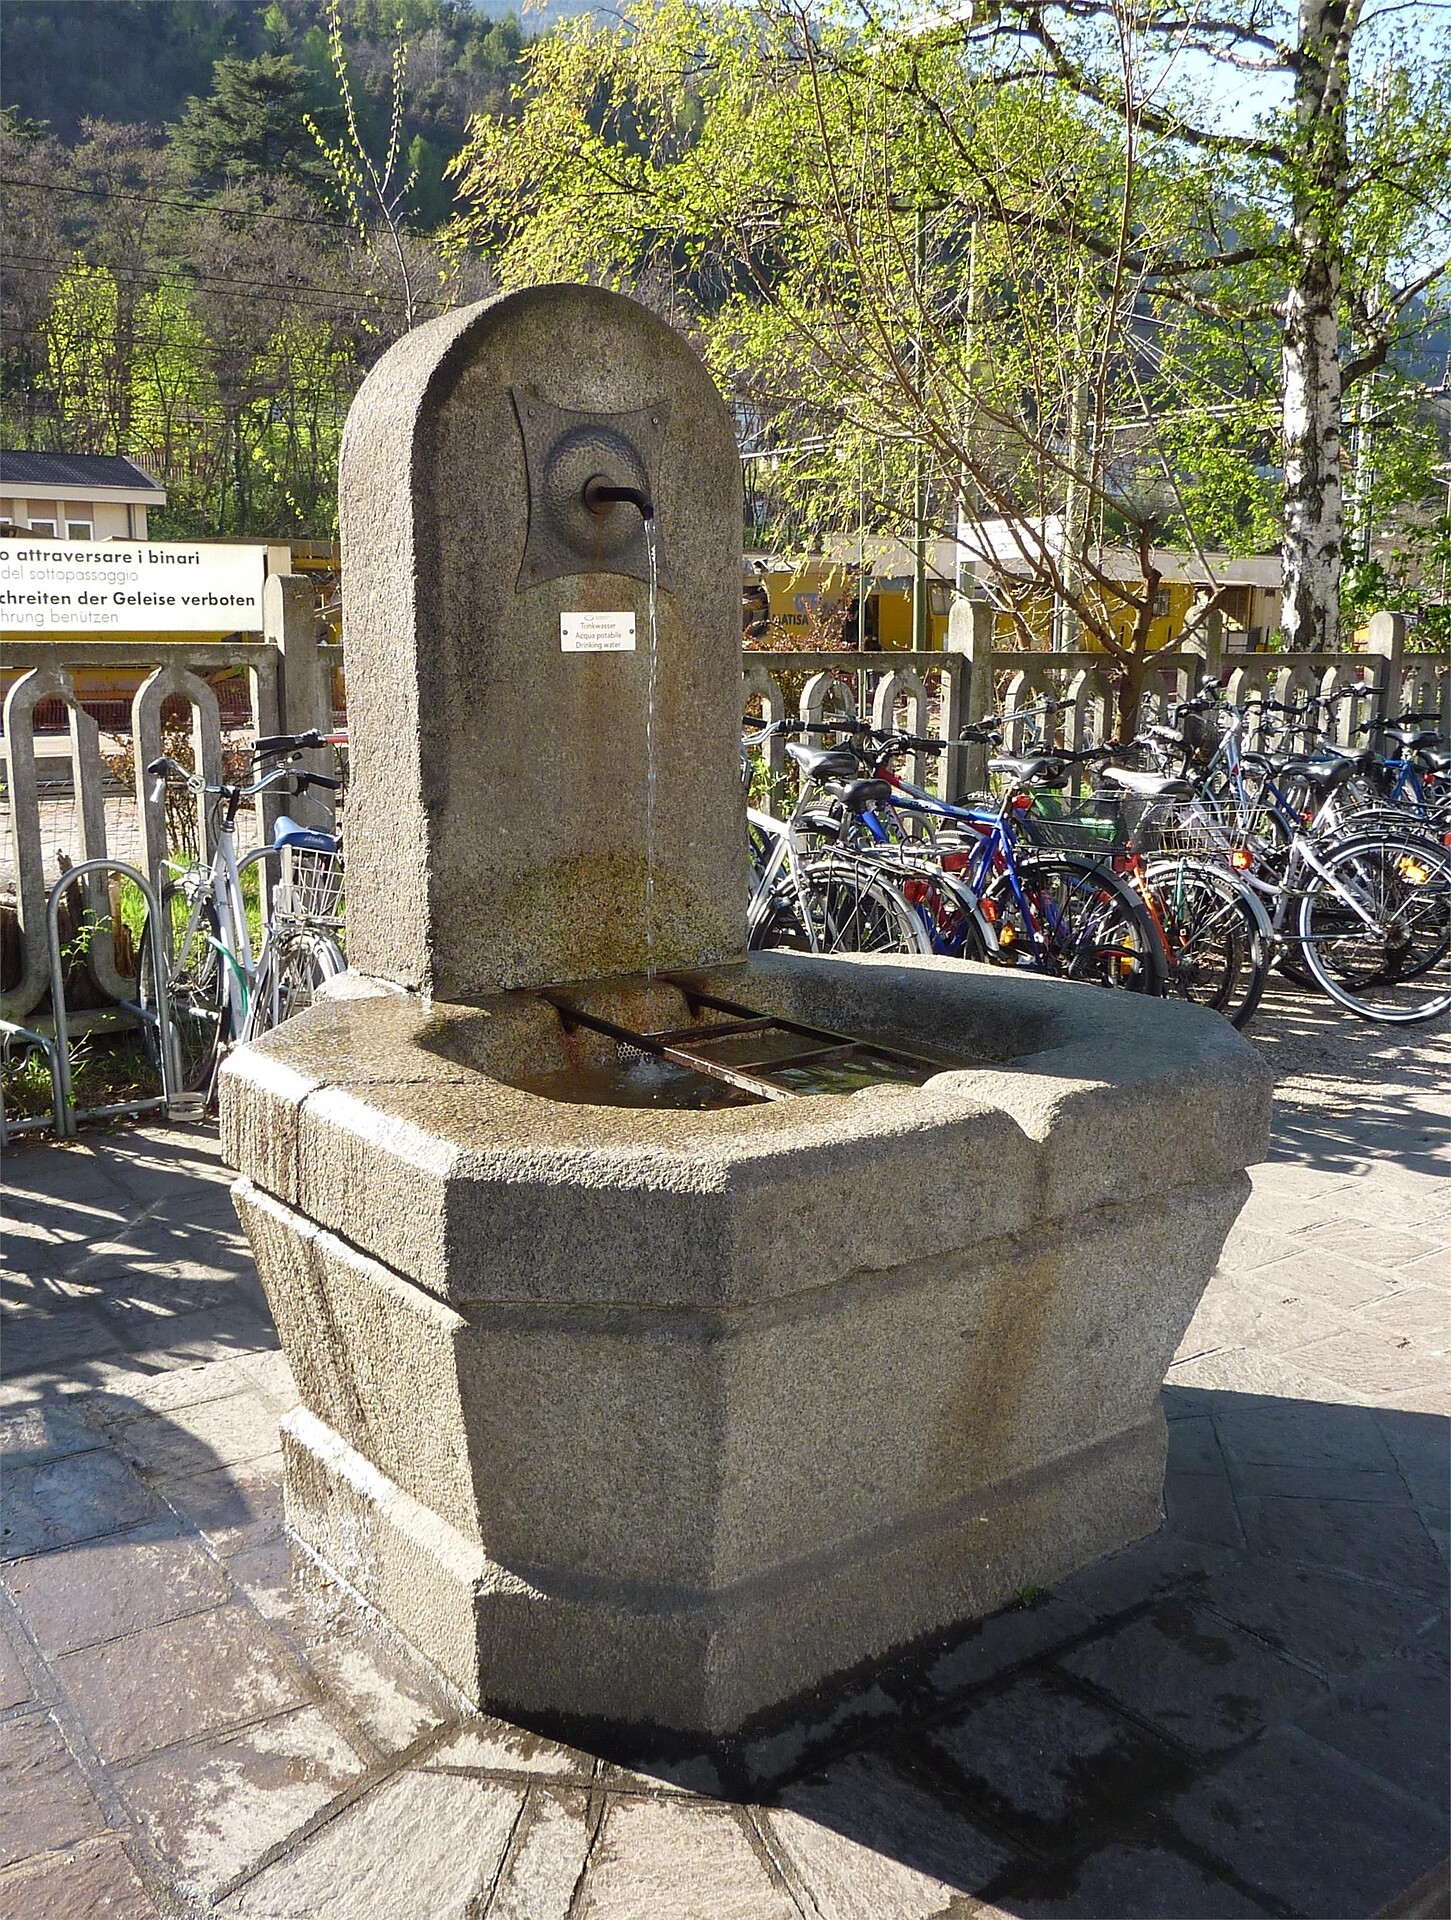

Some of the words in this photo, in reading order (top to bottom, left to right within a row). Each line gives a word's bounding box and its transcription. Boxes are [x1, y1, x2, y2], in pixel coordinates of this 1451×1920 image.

[0, 551, 9, 561] o
[17, 549, 132, 563] attraversare
[138, 550, 143, 563] i
[149, 550, 200, 564] binari
[1, 565, 23, 579] del
[30, 568, 139, 585] sottopassaggio
[0, 590, 71, 605] chreiten
[78, 591, 108, 605] der
[113, 591, 176, 605] Geleise
[181, 592, 255, 606] verboten
[1, 608, 44, 627] hrung
[50, 608, 119, 623] benützen
[580, 622, 616, 630] Trinkwasser
[576, 632, 595, 640] Acqua
[596, 632, 622, 640] potabile
[576, 641, 602, 649] Drinking
